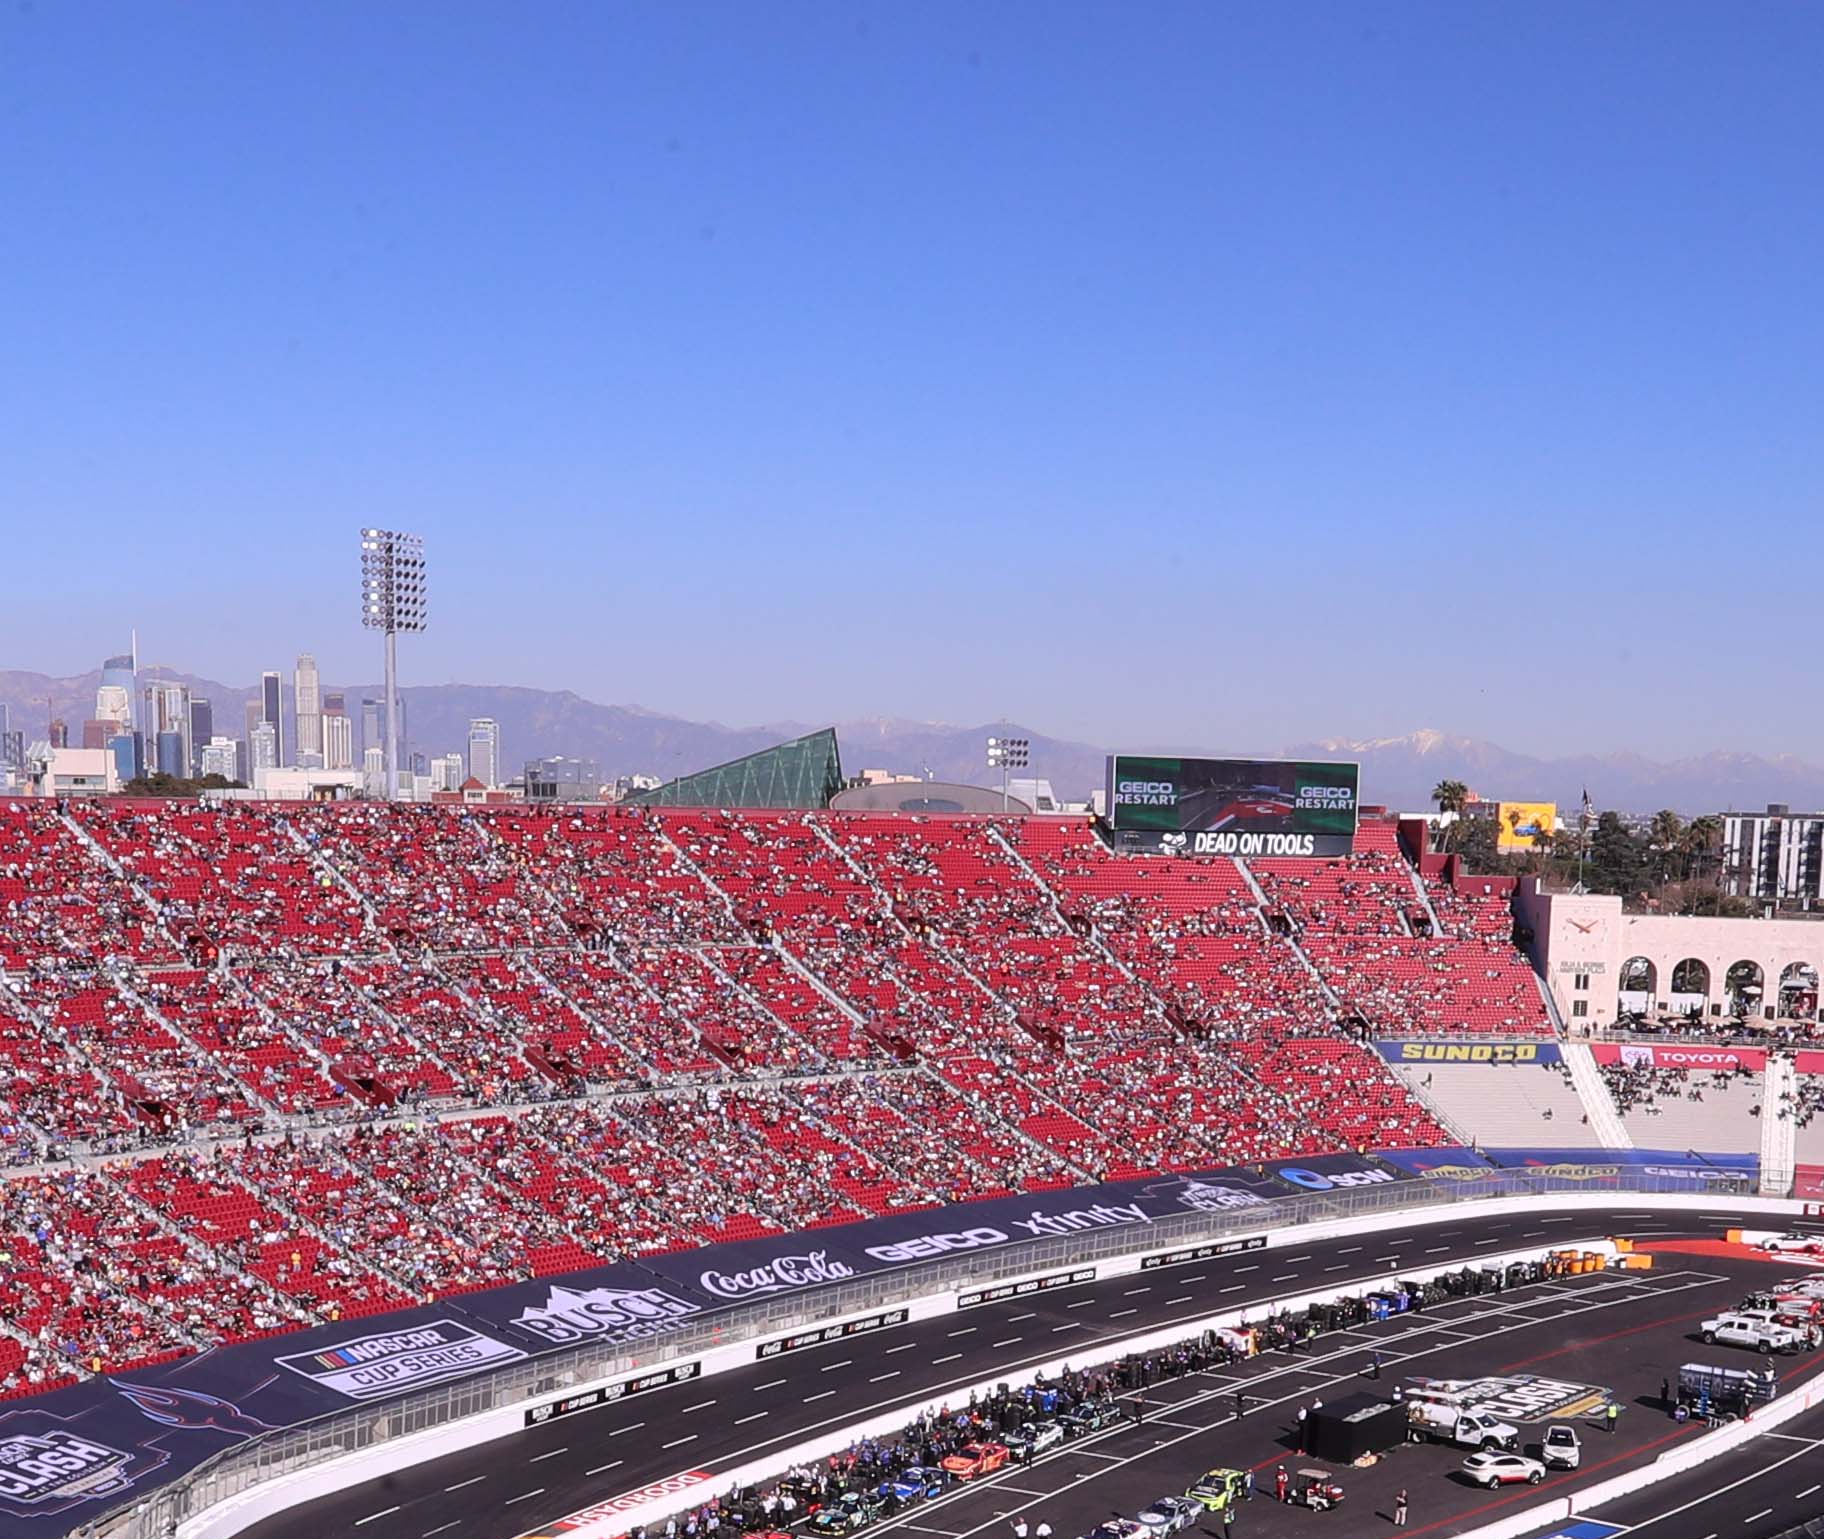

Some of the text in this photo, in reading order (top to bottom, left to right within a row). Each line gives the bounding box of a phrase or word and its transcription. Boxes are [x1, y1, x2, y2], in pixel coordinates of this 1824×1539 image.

[1119, 782, 1173, 794] GEICO
[1300, 786, 1352, 798] GEICO
[1115, 794, 1178, 806] RESTART
[1295, 798, 1355, 810] RESTART
[1194, 832, 1315, 856] DEAD ON TOOLS
[1401, 1044, 1536, 1061] SUNOCO
[1659, 1052, 1739, 1065] TOYOTA
[1328, 1168, 1395, 1187] SCW
[1529, 1165, 1618, 1177] SUNOCO
[1644, 1166, 1749, 1180] GEICO
[1012, 1203, 1153, 1237] xfinity
[863, 1227, 1009, 1262] GEICO
[699, 1250, 857, 1299] Coca-Cola
[1073, 1270, 1094, 1281] GEICO
[526, 1290, 701, 1342] BUSCH
[346, 1329, 451, 1362] NASCAR
[351, 1345, 484, 1386] CUP SERIES
[1477, 1379, 1586, 1418] CLASH
